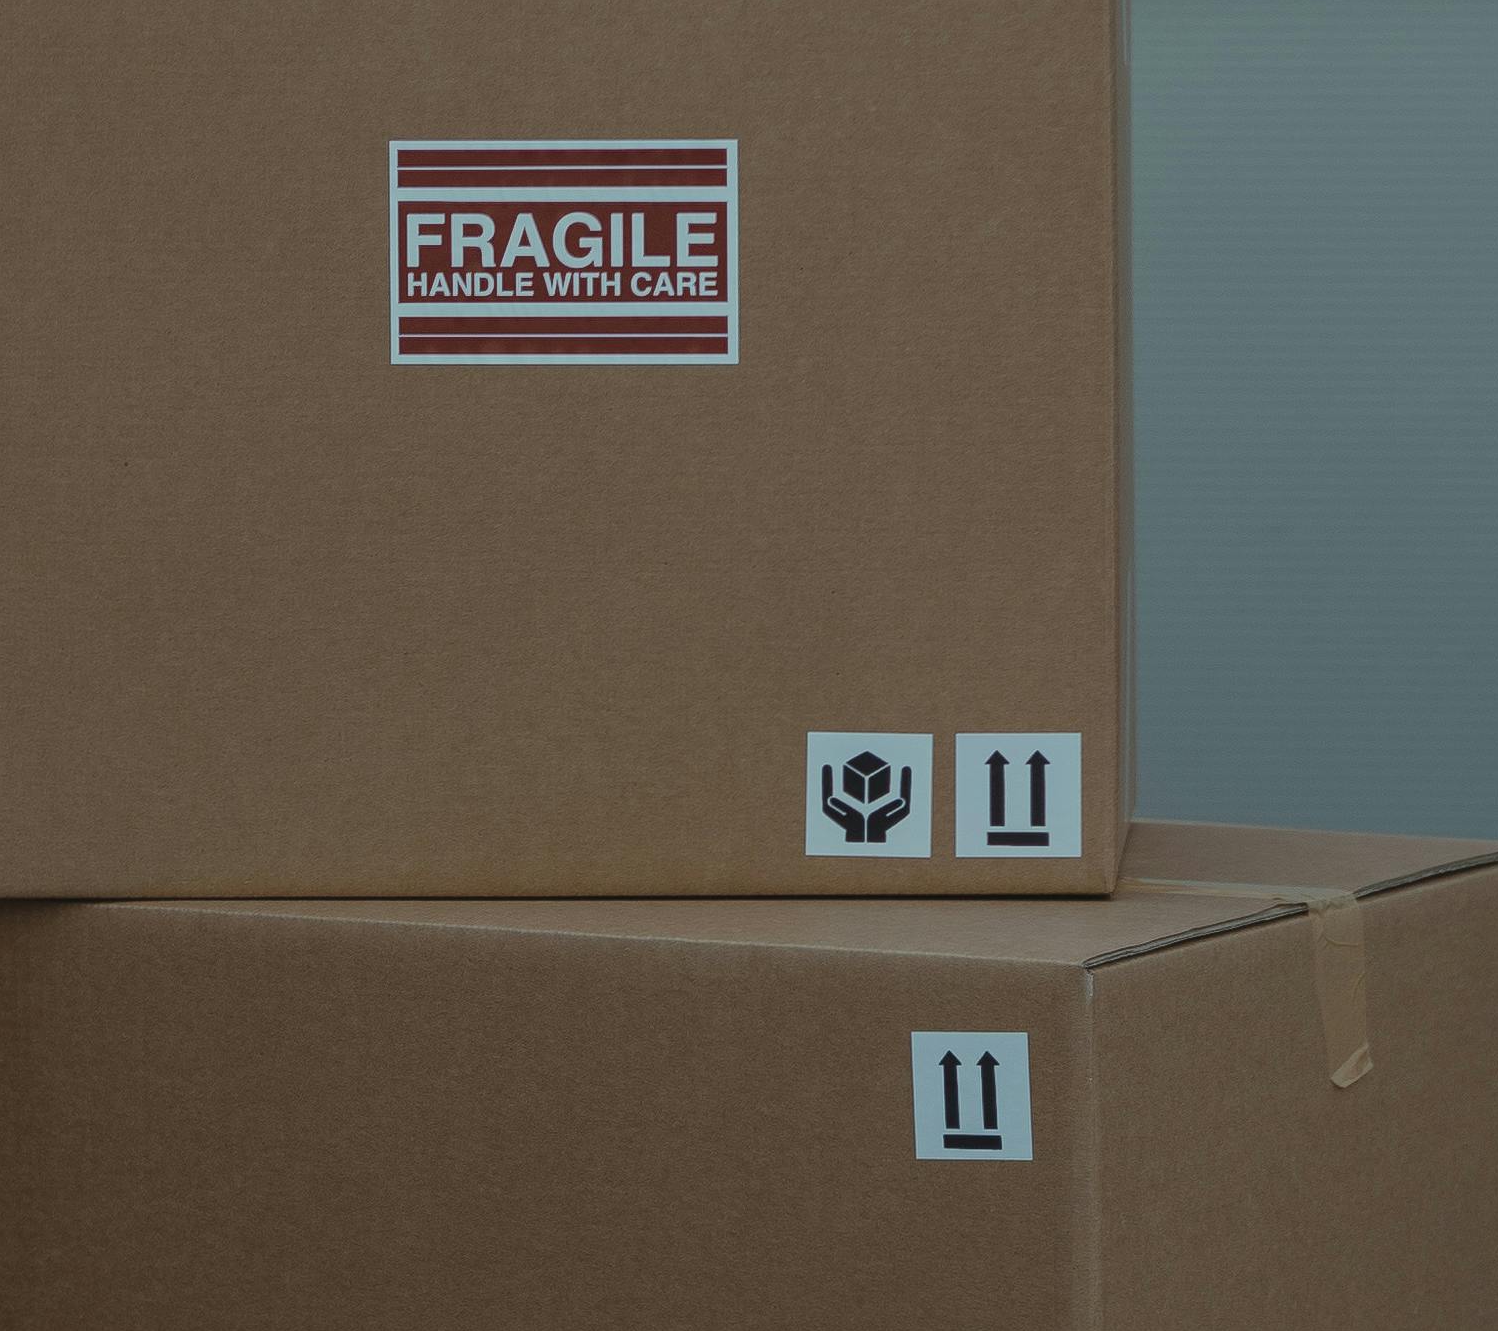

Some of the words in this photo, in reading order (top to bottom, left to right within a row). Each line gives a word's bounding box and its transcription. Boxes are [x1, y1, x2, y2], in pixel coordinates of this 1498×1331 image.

[406, 211, 719, 269] FRAGILE
[407, 271, 534, 297] HANDLE
[543, 271, 621, 297] WITH
[630, 271, 719, 297] CARE
